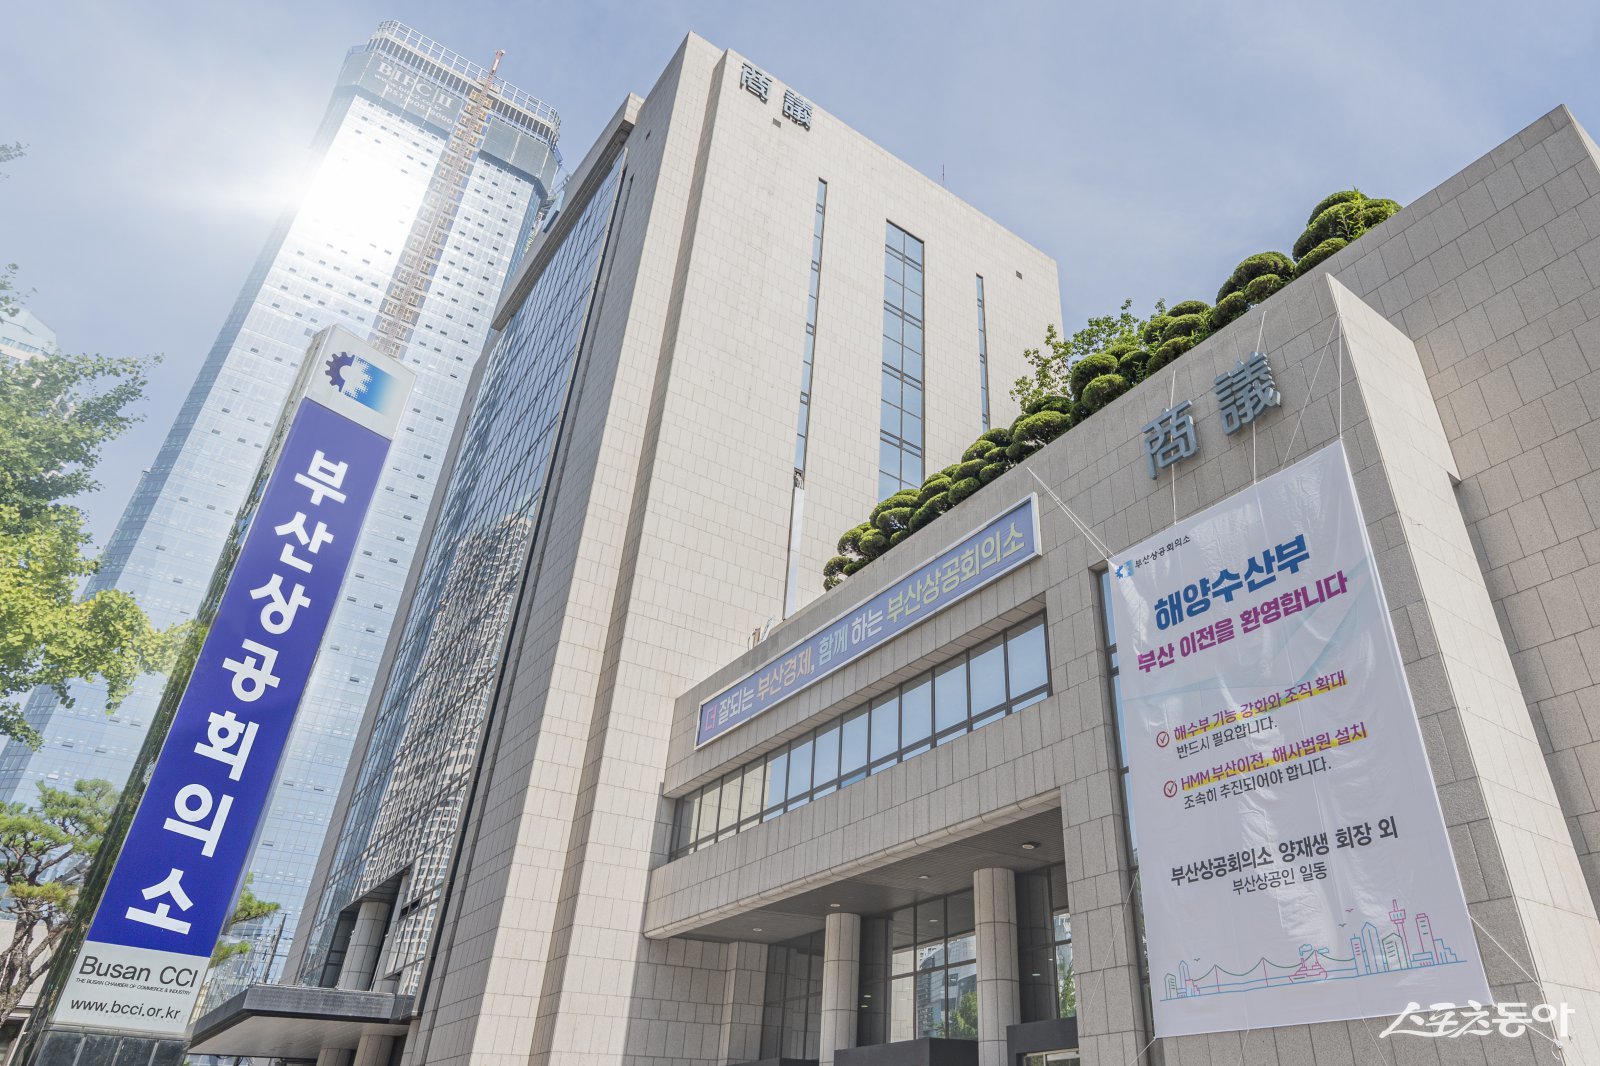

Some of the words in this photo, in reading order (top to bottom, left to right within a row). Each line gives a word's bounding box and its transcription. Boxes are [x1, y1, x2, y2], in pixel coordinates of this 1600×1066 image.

[377, 62, 432, 97] BIFC
[1141, 352, 1281, 480] 商議
[1134, 535, 1191, 568] 부산상공회의소
[1154, 533, 1310, 630] 해양수산부
[705, 704, 718, 732] 더
[718, 687, 755, 726] 잘되는
[757, 646, 815, 701] 부산경제,
[818, 623, 849, 666] 함께
[851, 609, 884, 645] 하는
[887, 522, 1025, 624] 부산상공회의소
[1138, 643, 1175, 673] 부산
[1180, 617, 1235, 657] 이전을
[1240, 570, 1348, 634] 환영합니다
[125, 449, 348, 935] 부산상공회의소
[1173, 716, 1211, 741] 해수부
[1212, 709, 1237, 729] 기능
[1240, 692, 1281, 719] 강화와
[1285, 681, 1313, 704] 조직
[1316, 670, 1346, 693] 확대
[1176, 736, 1210, 760] 반드시
[1212, 716, 1278, 747] 필요합니다.
[1181, 770, 1211, 791] HMM
[1212, 752, 1269, 781] 부산이전,
[1271, 732, 1331, 763] 해사법원
[1334, 721, 1367, 746] 설치
[1183, 787, 1217, 810] 조속히
[1219, 769, 1284, 799] 추진되어야
[1285, 756, 1332, 781] 합니다.
[1170, 846, 1274, 887] 부산상공회의소
[1278, 832, 1330, 863] 양재생
[1335, 822, 1372, 849] 회장
[1377, 815, 1399, 839] 외
[1232, 867, 1296, 896] 부산상공인
[1299, 861, 1328, 882] 일동
[79, 955, 151, 982] Busan
[159, 966, 198, 988] CCI
[104, 981, 129, 989] CHAMBER
[136, 984, 164, 993] COMMERCE
[169, 988, 191, 996] INDUSTRY
[70, 999, 181, 1019] www.bcci.or.kr
